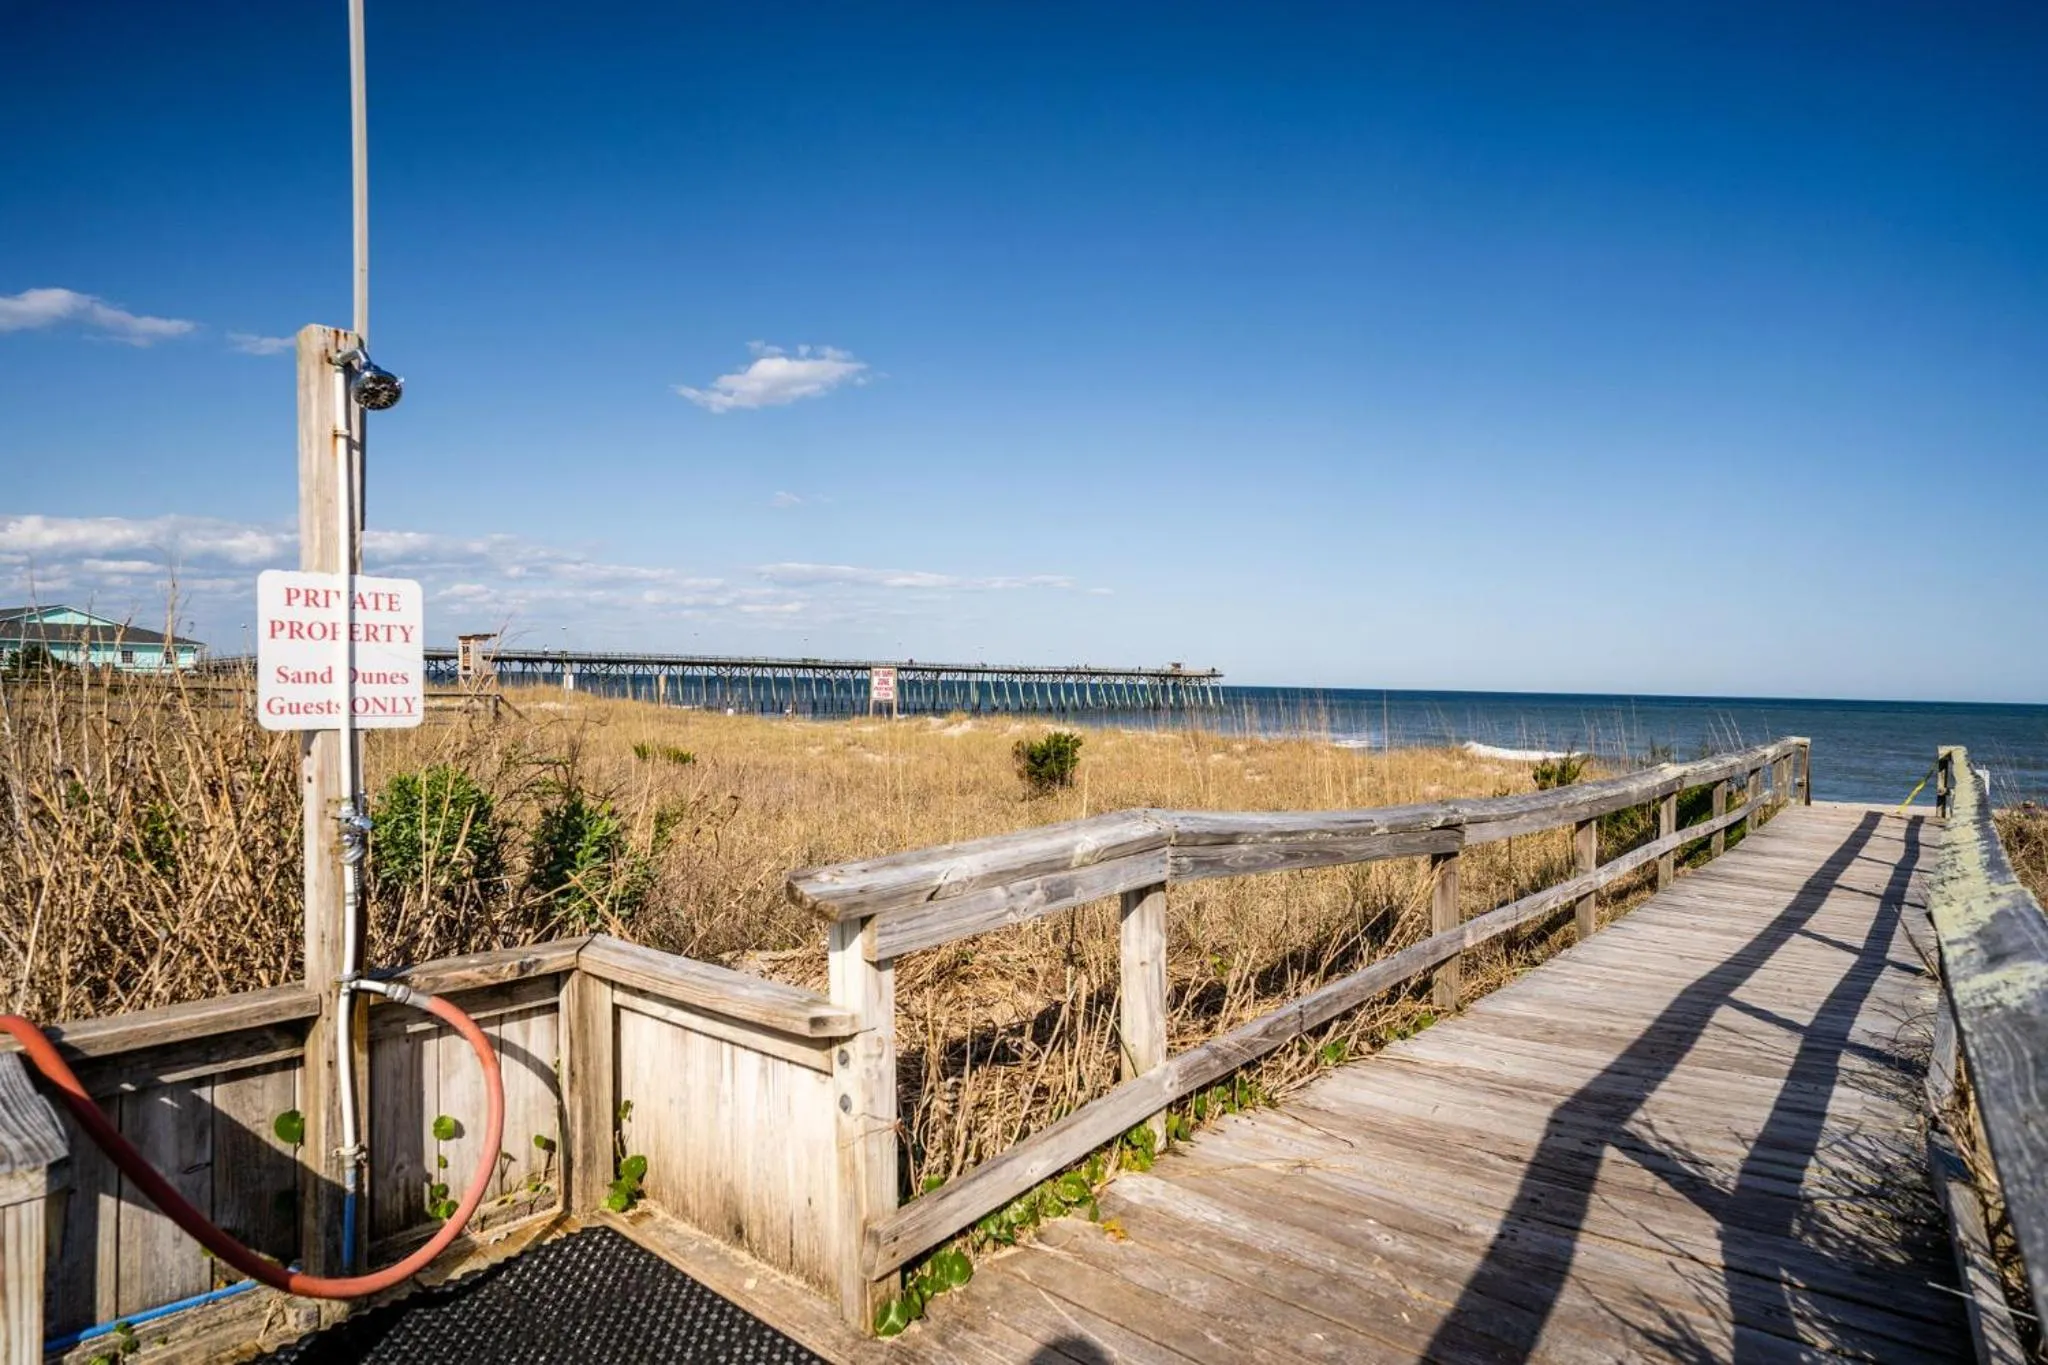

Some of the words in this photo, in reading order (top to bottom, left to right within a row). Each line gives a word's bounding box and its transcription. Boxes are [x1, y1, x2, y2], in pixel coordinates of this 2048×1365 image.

[276, 665, 333, 684] Sand
[266, 696, 341, 716] Guests
[351, 696, 417, 715] ONLY
